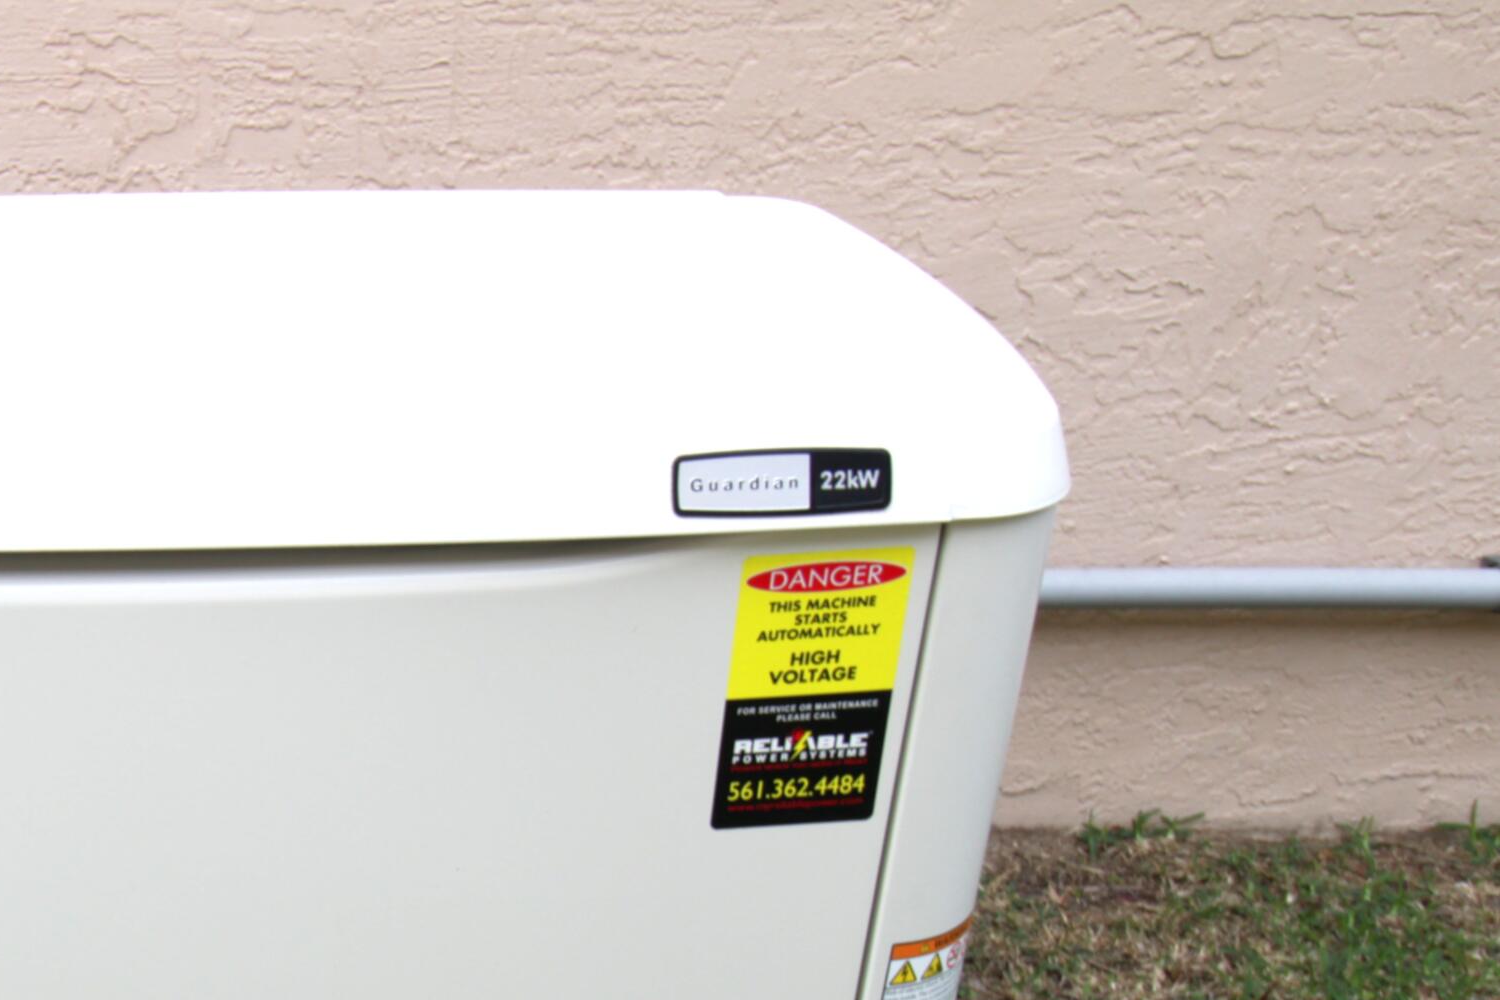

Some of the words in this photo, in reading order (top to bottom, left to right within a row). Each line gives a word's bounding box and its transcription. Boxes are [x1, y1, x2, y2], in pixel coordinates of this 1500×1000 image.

[690, 476, 799, 493] Guardian
[819, 468, 880, 490] 22kW
[769, 564, 883, 590] DANGER
[769, 600, 801, 613] THIS
[806, 595, 877, 610] MACHINE
[794, 611, 847, 626] STARTS
[756, 623, 881, 643] AUTOMATICALLY
[790, 649, 841, 667] HIGH
[769, 666, 857, 685] VOLTAGE
[737, 707, 756, 716] FOR
[758, 704, 796, 715] SERVICE
[799, 703, 813, 712] OR
[814, 699, 879, 711] MAINTENANCE
[776, 712, 812, 723] PLEASE
[813, 711, 837, 720] CALL
[733, 730, 869, 755] RELIABLE
[731, 752, 788, 765] POWER
[800, 747, 867, 761] SYSTEMS
[727, 773, 866, 802] 561.362.4484
